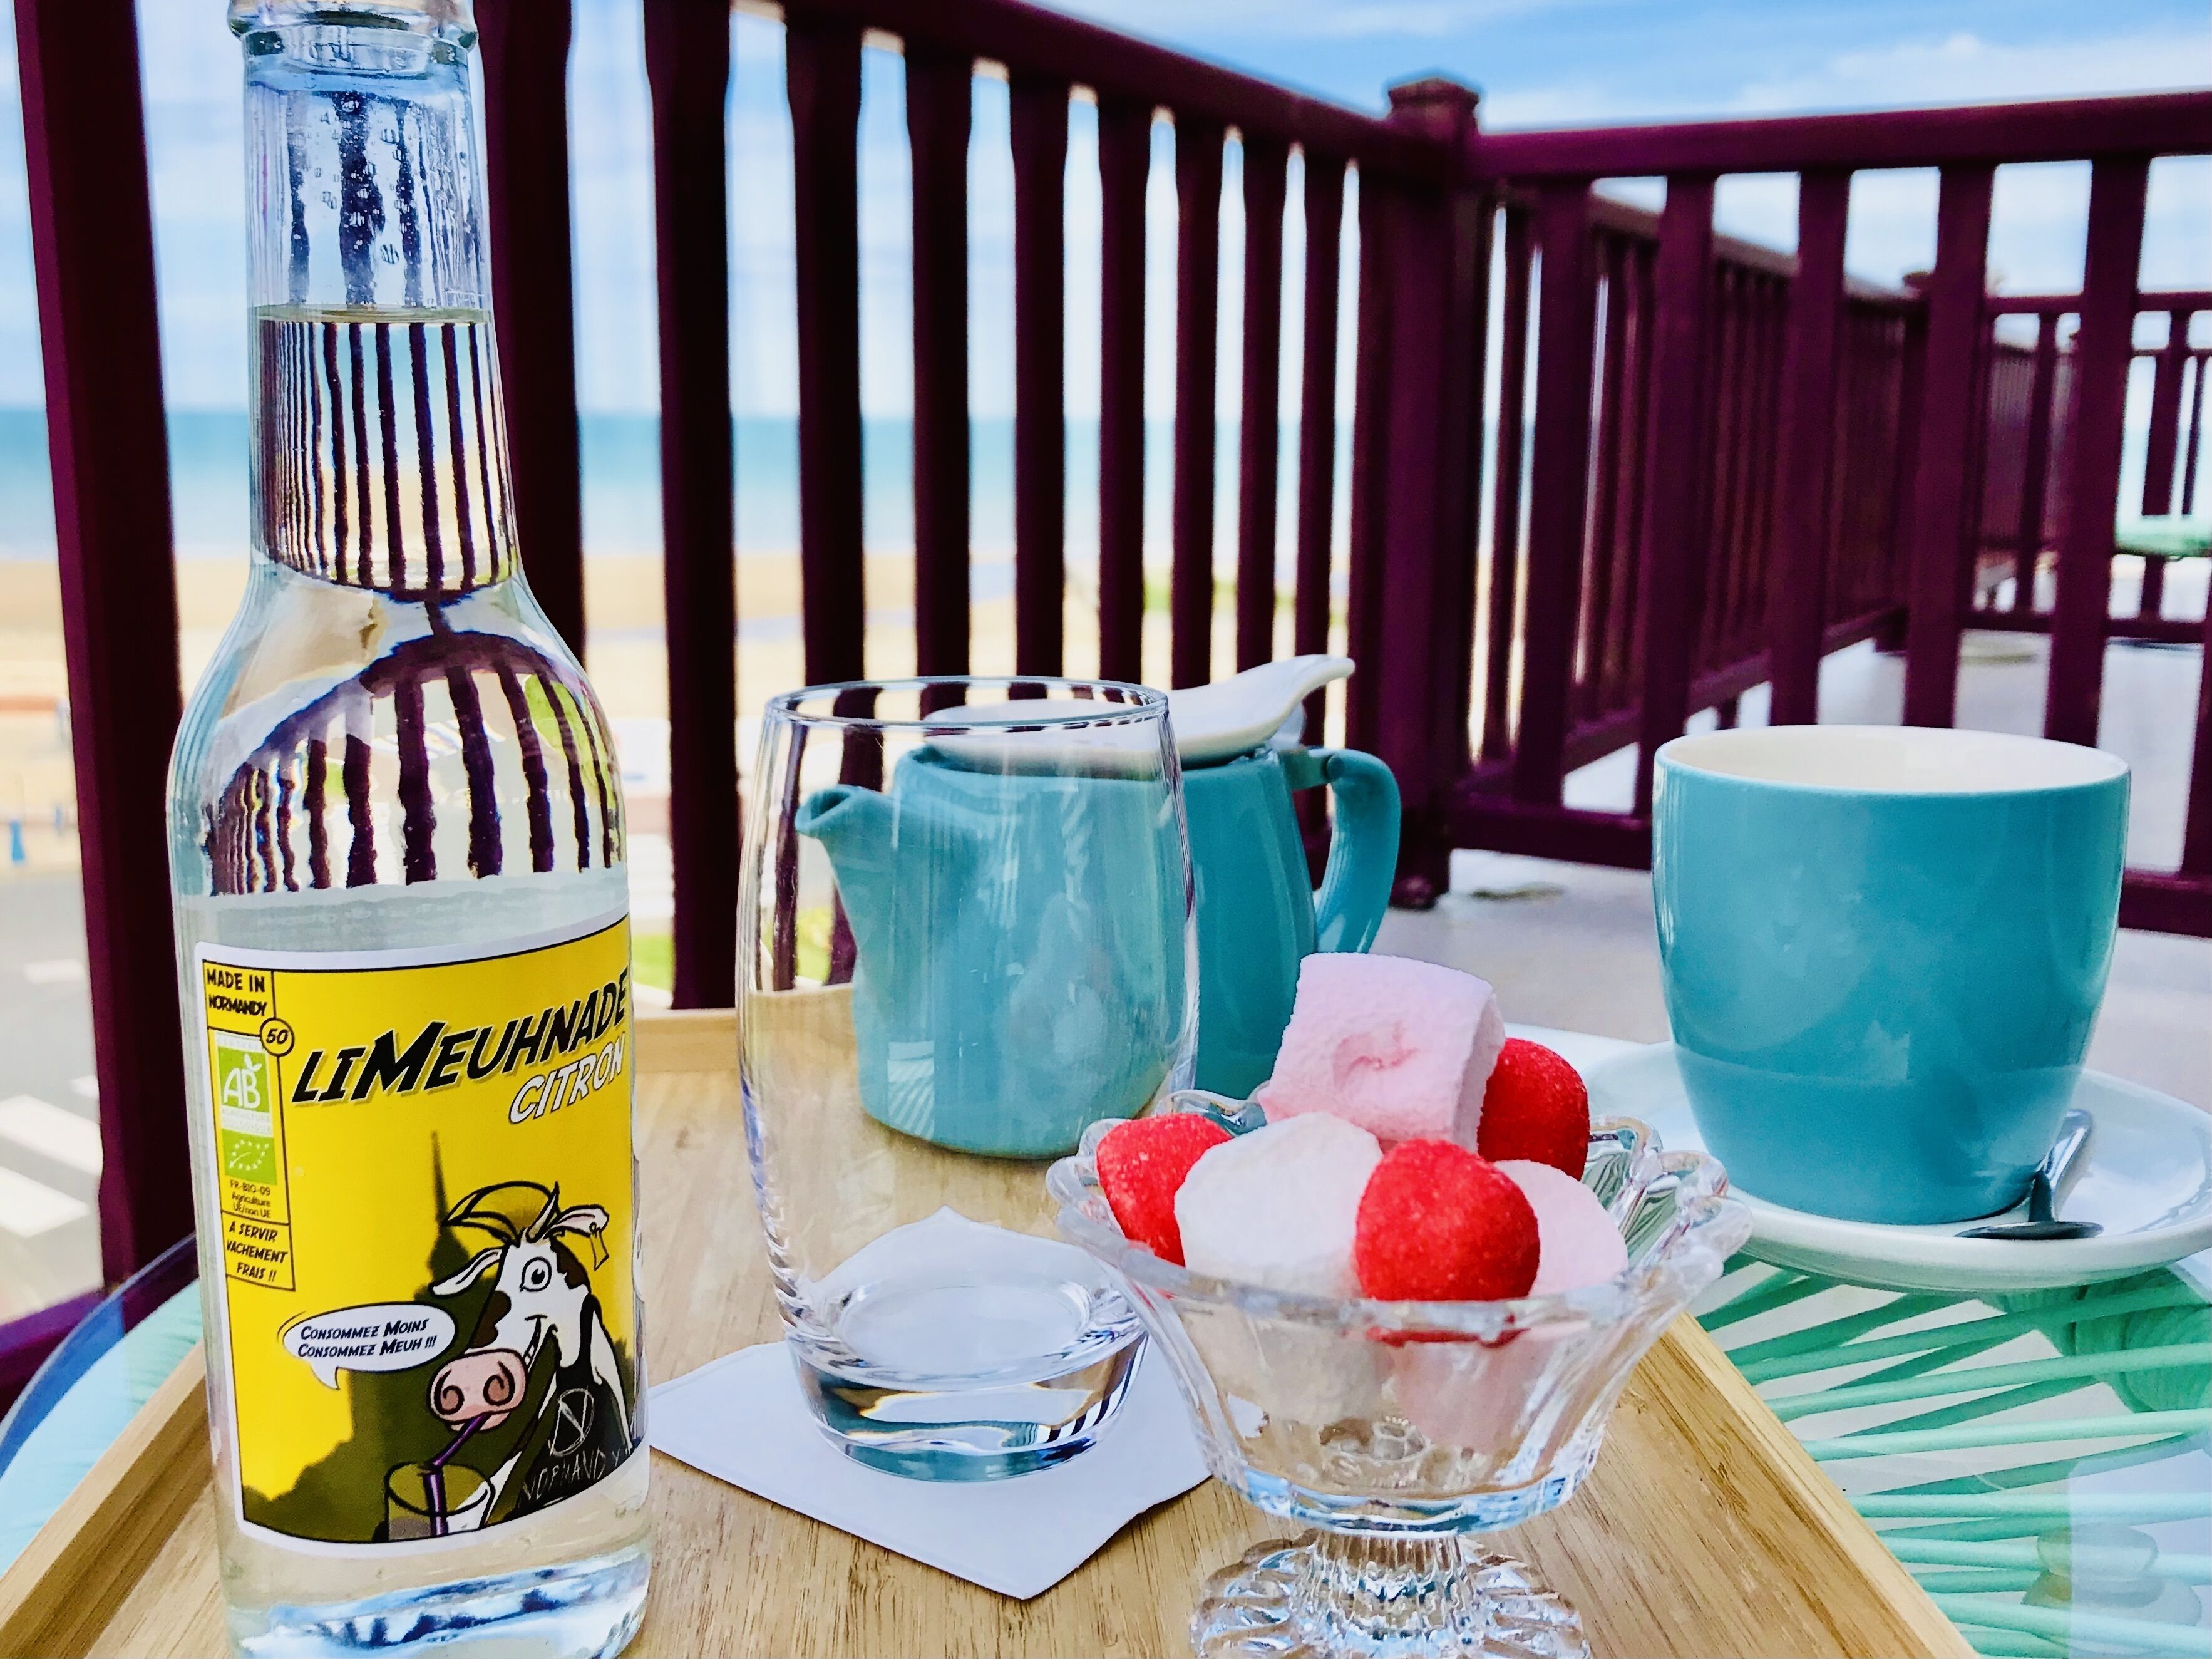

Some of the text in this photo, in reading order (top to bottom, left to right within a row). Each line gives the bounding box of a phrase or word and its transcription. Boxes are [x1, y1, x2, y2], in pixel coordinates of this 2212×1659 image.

[207, 968, 265, 992] MADE IN
[208, 994, 267, 1016] NORMANDY
[266, 1028, 288, 1045] 50
[223, 1067, 261, 1109] AB
[508, 1031, 625, 1124] CITRON
[239, 1223, 278, 1242] SERVIR
[227, 1239, 288, 1263] VACHEMENT
[237, 1262, 265, 1279] FRAIS
